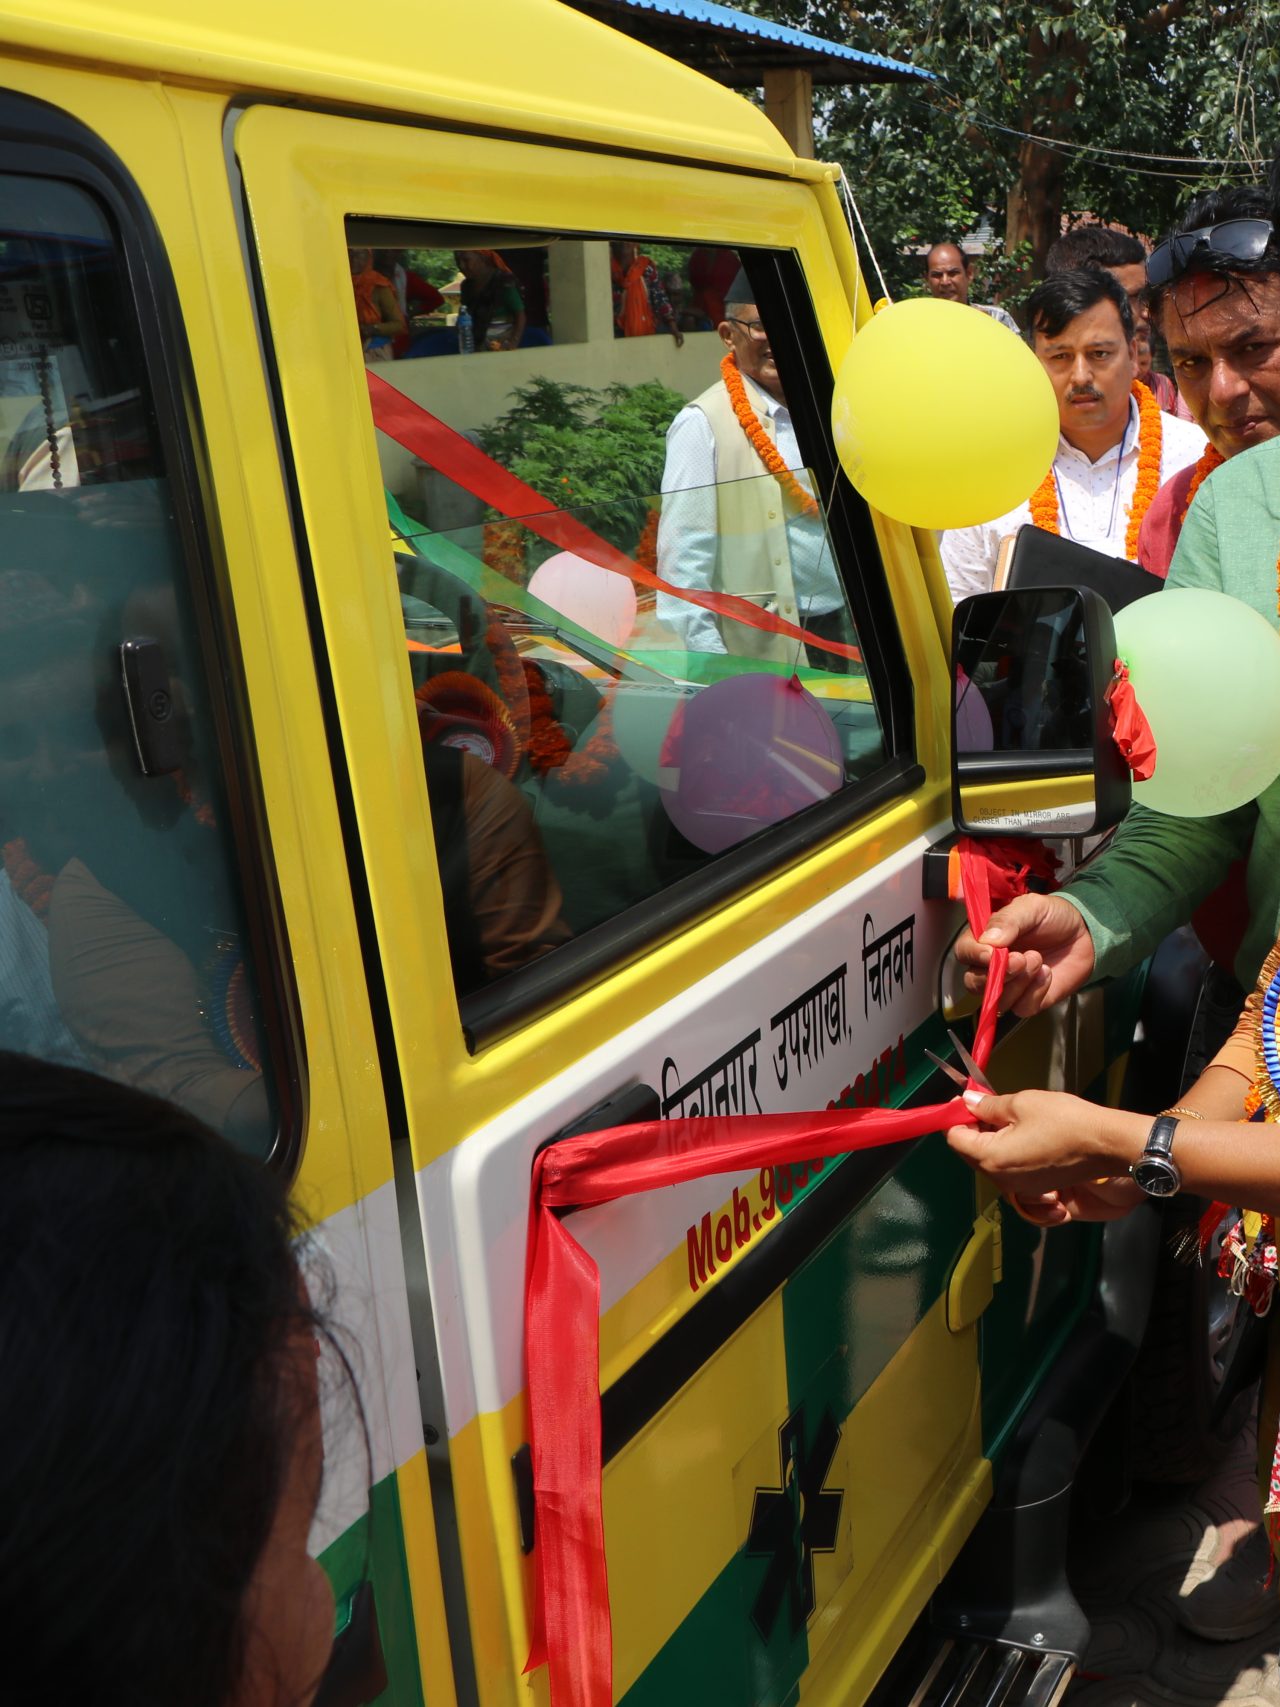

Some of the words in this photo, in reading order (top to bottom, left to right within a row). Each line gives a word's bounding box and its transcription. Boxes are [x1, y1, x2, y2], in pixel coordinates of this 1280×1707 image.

[979, 807, 1006, 817] OBJECT
[1011, 808, 1020, 817] IN
[1023, 810, 1052, 820] MIRROR
[973, 815, 1000, 825] CLOSER
[1005, 817, 1022, 826] THAN
[770, 962, 853, 1092] उपशाखा,
[862, 913, 916, 1021] चितवन
